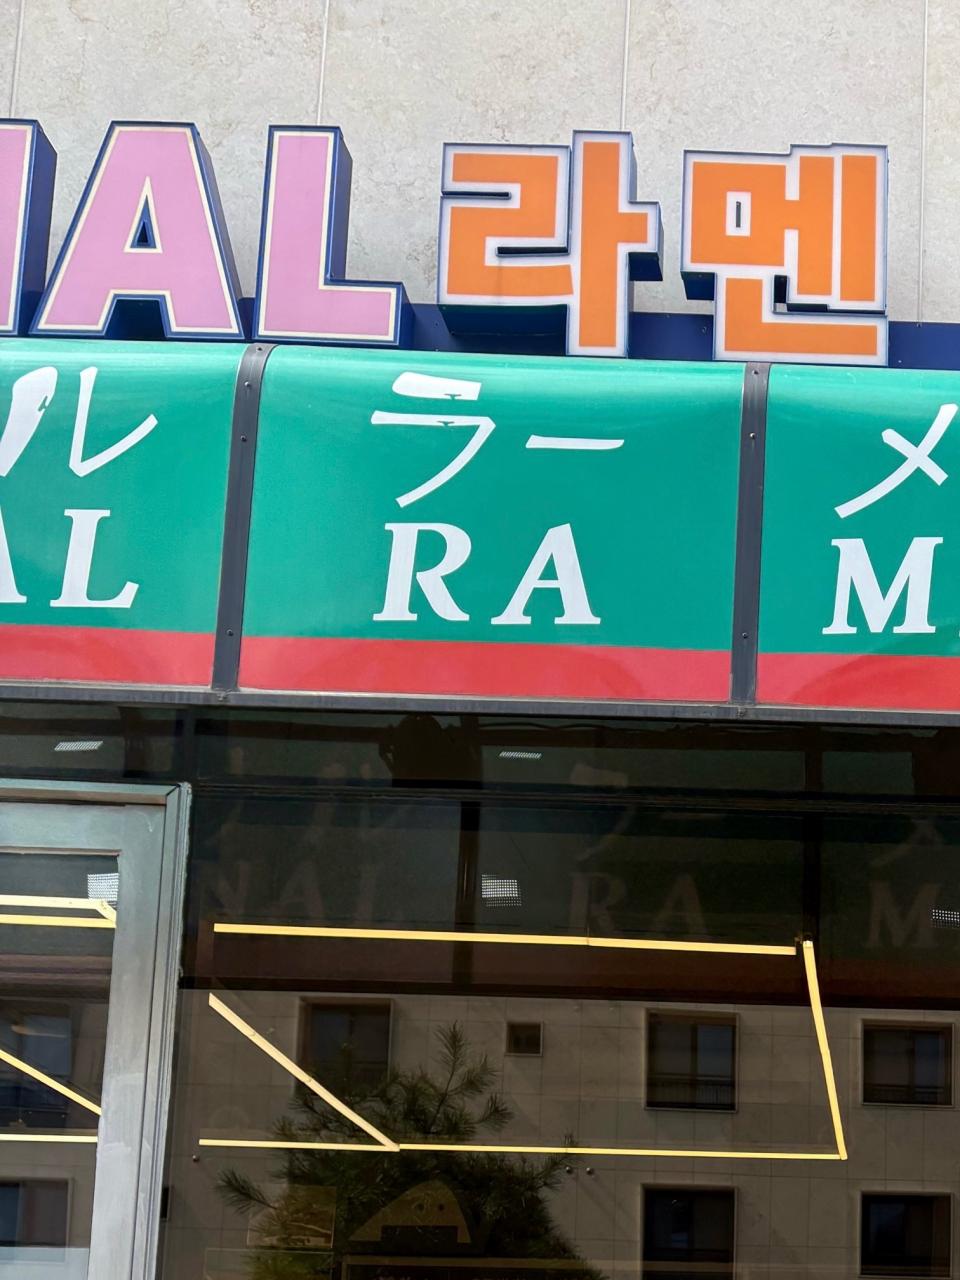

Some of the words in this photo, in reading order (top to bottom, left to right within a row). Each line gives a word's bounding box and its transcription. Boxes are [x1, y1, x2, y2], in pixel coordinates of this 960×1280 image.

[437, 130, 889, 367] 라멘
[371, 371, 625, 508] ラー
[373, 521, 600, 626] RA
[567, 872, 709, 937] RA
